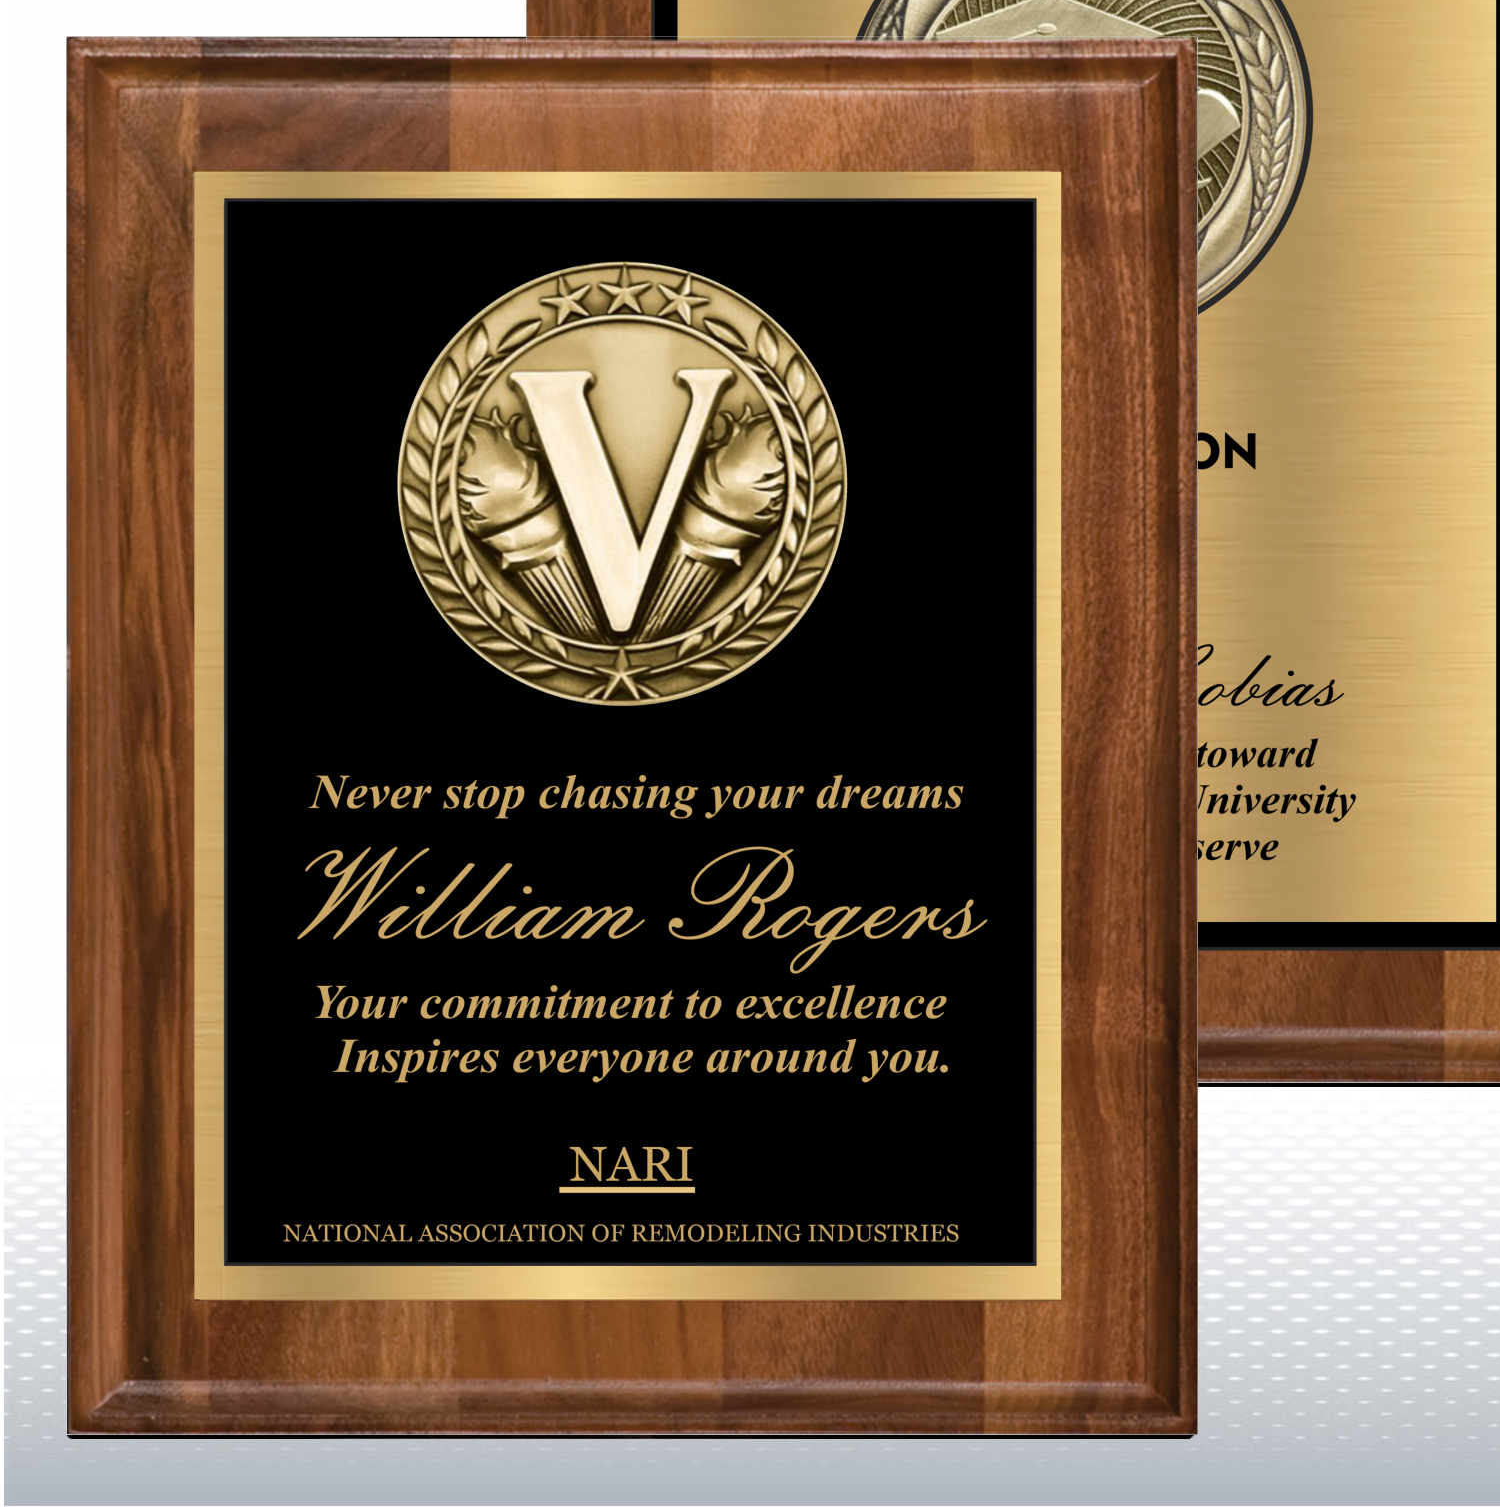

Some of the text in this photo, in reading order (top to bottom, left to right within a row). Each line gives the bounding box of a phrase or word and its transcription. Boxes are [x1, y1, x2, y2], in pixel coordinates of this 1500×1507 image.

[508, 368, 737, 633] V
[1198, 643, 1345, 707] obias
[1198, 738, 1319, 768] toward
[308, 774, 964, 819] Never stop chasing your dreams
[296, 846, 988, 975] William Rogers
[315, 984, 947, 1020] Your commitment to excellence
[332, 1038, 950, 1083] Inspires everyone around you.
[569, 1146, 693, 1183] NARI
[283, 1223, 959, 1244] NATIONAL ASSOCIATION OF REMODELING INDUSTRIES
